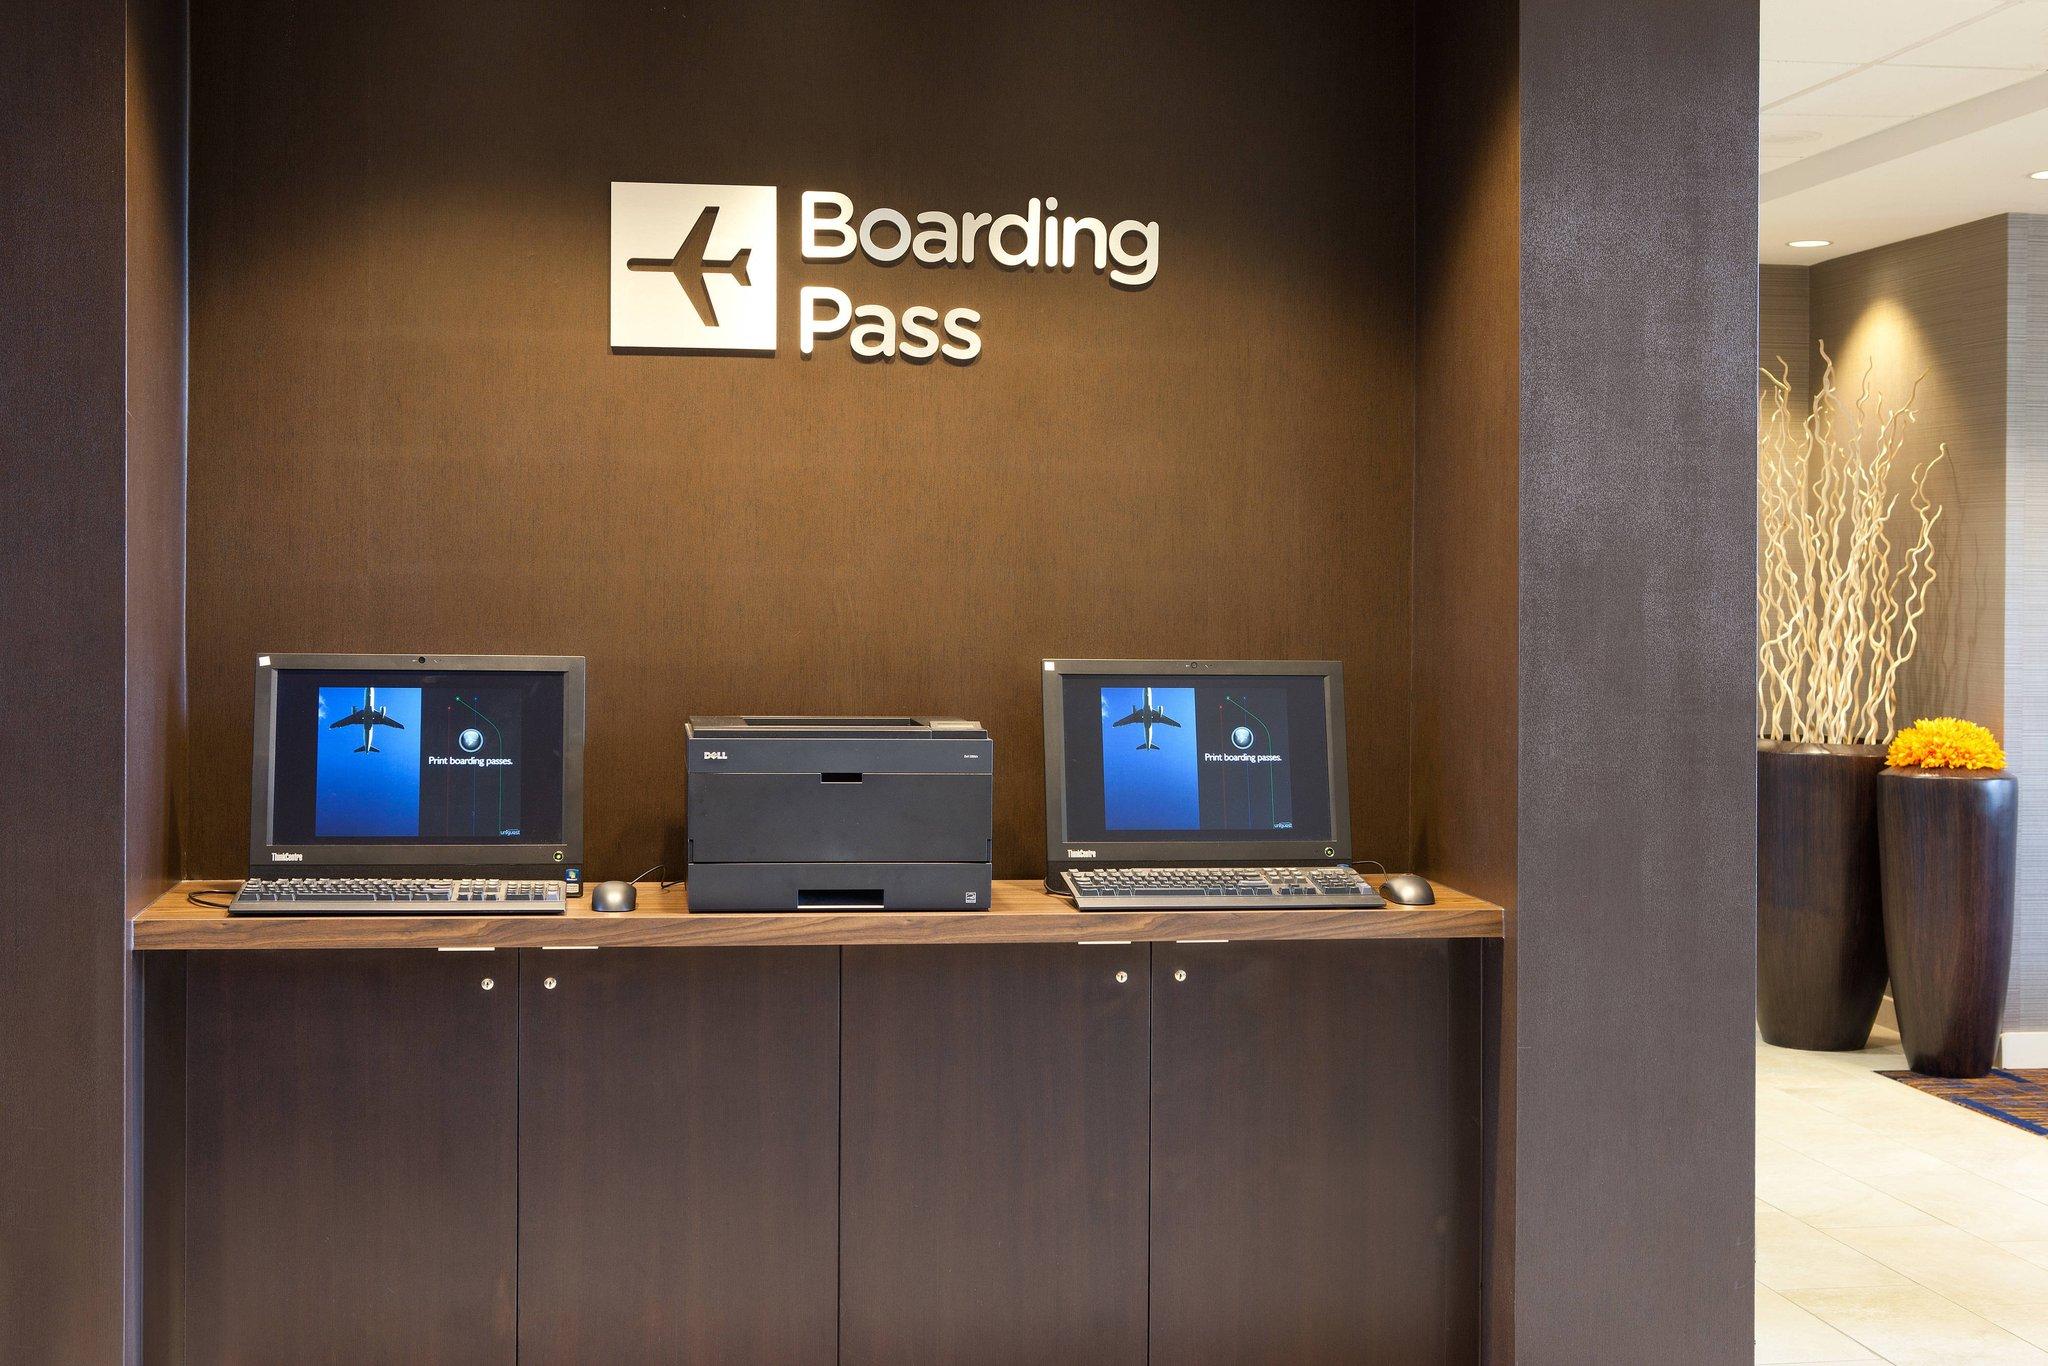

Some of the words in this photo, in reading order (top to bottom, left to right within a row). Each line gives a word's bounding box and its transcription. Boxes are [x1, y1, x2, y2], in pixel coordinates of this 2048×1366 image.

[800, 190, 1160, 286] Boarding
[799, 285, 983, 361] Pass
[703, 751, 728, 760] DELL
[1204, 752, 1223, 762] Print
[1223, 753, 1256, 764] boarding
[1257, 754, 1283, 764] passes.
[428, 756, 448, 765] Print
[449, 756, 485, 767] boarding
[486, 758, 514, 767] passes.
[271, 852, 304, 862] ThinkCentre
[1067, 849, 1097, 858] ThinkCentre
